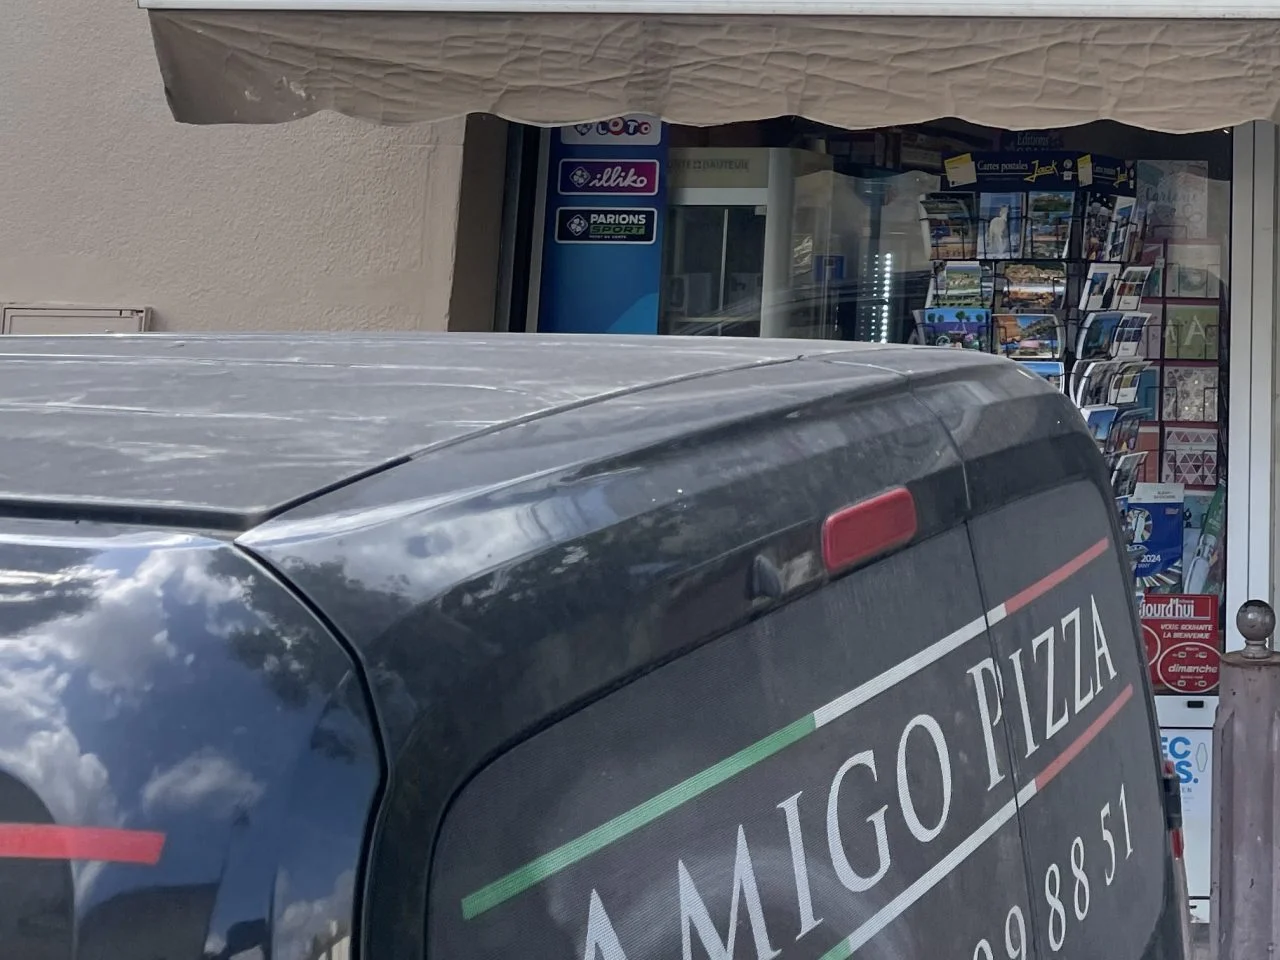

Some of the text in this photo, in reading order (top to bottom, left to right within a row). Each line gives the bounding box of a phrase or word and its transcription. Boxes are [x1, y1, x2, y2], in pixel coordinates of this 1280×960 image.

[596, 116, 652, 136] LOTO
[588, 166, 648, 188] illiko
[977, 159, 1060, 183] Cartes postales Jack
[590, 213, 647, 225] PARIONS
[590, 225, 645, 235] SPORT
[1140, 554, 1161, 563] 2024
[1138, 597, 1196, 619] jourd'hui
[1168, 663, 1218, 674] dimanche
[966, 594, 1118, 792] PIZZA
[972, 783, 1133, 960] 9 88 51
